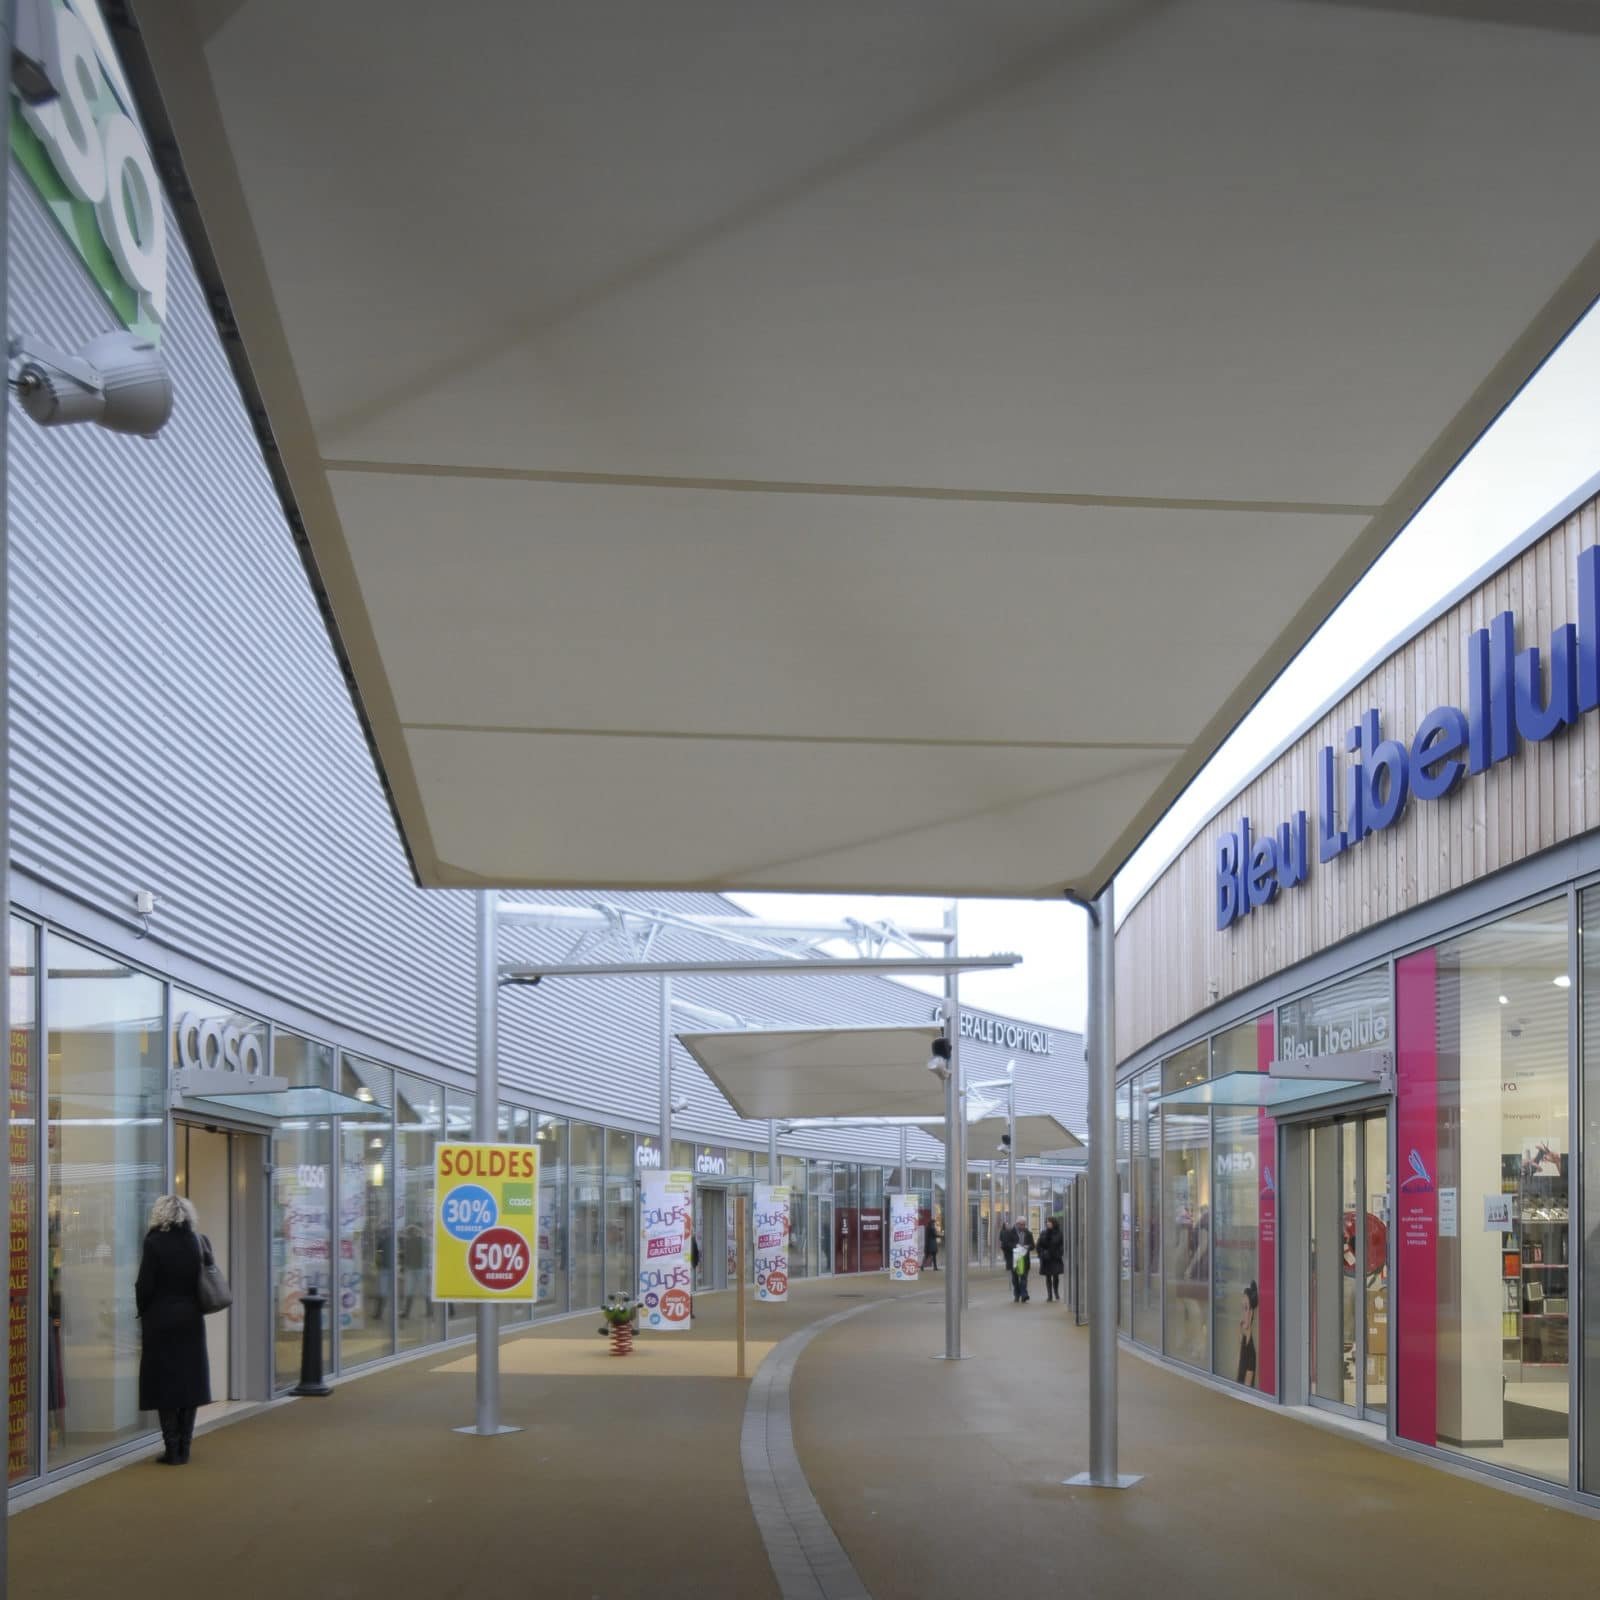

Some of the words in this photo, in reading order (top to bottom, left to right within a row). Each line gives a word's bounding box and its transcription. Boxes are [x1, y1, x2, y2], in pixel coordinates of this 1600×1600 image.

[1216, 810, 1308, 931] Bleu
[1319, 545, 1600, 864] Libellul
[995, 1022, 1055, 1054] D'OPTIQUE
[1283, 1035, 1313, 1061] Bleu
[1318, 1007, 1386, 1057] Libellule
[440, 1149, 534, 1178] SOLDES
[447, 1199, 491, 1223] 30%
[475, 1243, 524, 1271] 50%
[640, 1266, 690, 1293] SOLDES
